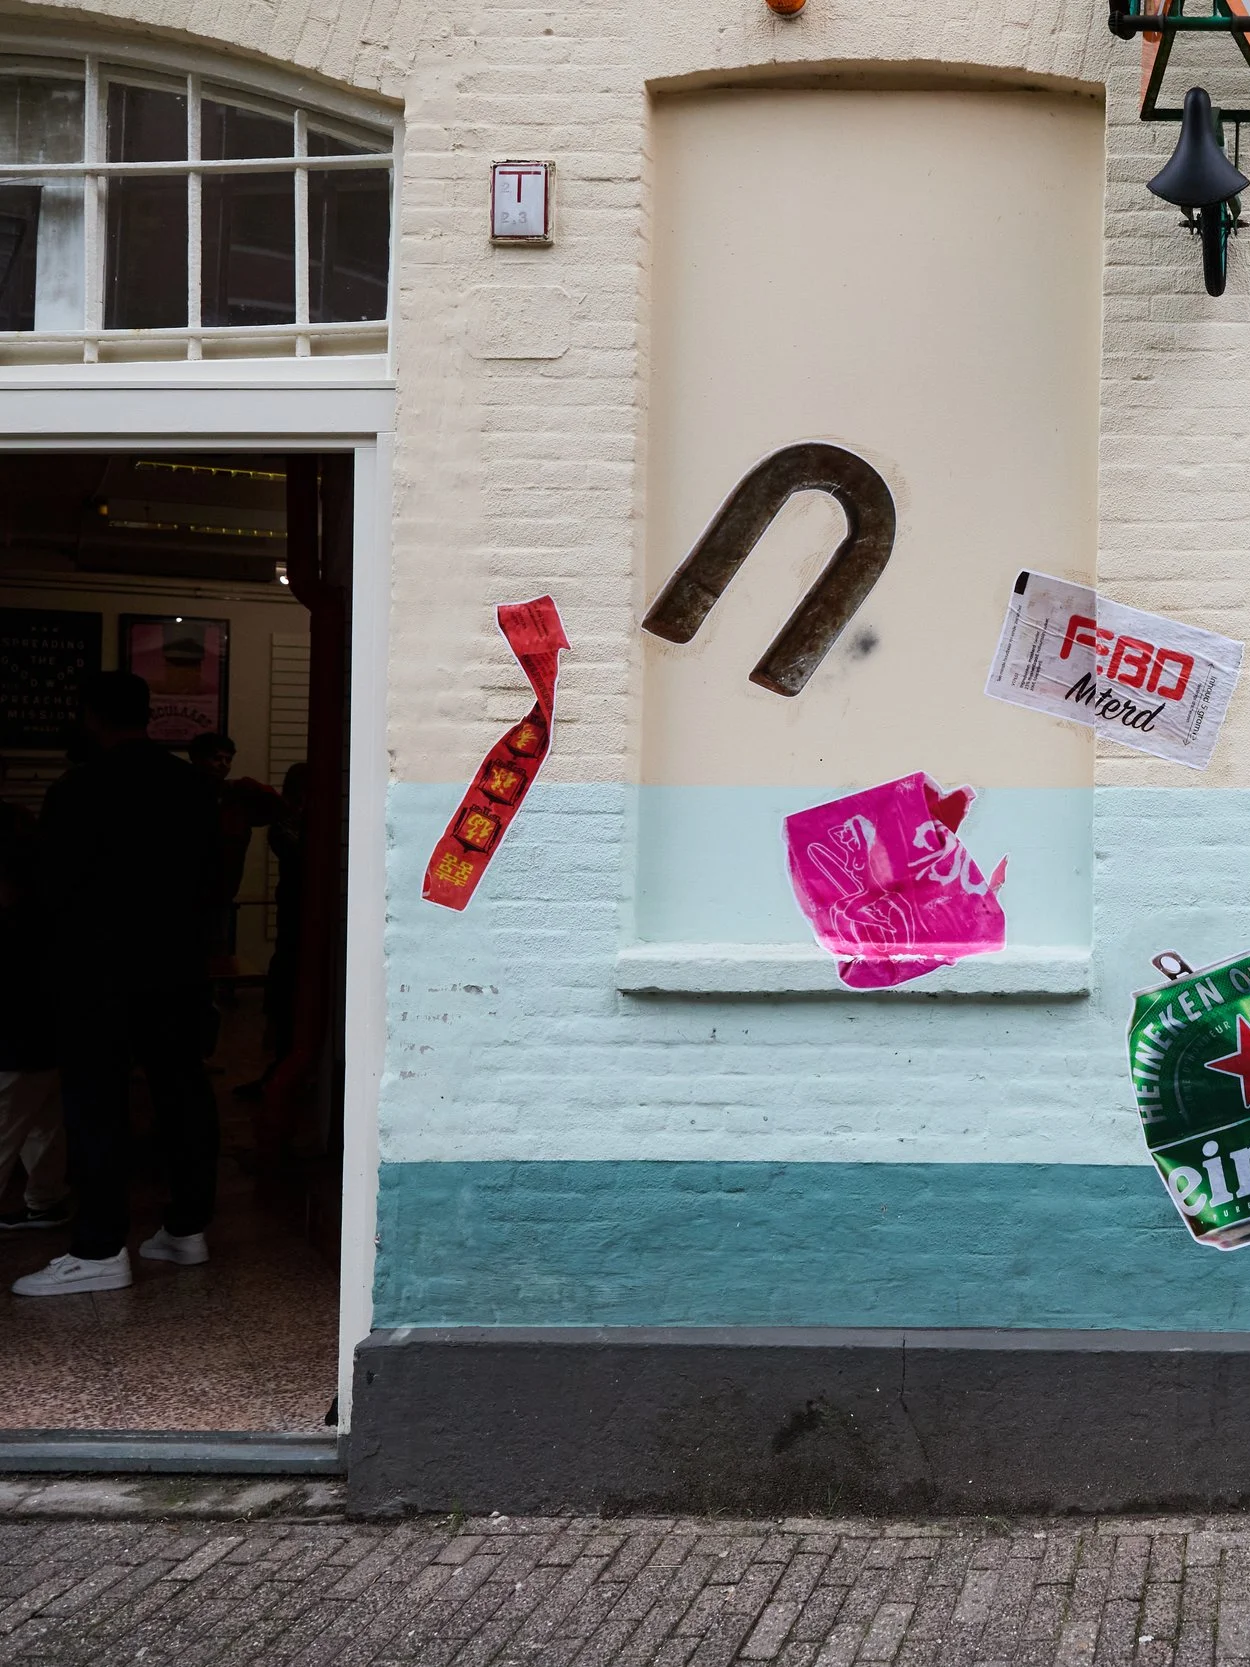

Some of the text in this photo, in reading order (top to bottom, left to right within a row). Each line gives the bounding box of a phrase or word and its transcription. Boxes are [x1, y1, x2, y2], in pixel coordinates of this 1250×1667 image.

[498, 170, 542, 203] T
[1059, 614, 1195, 702] FEBO
[1132, 976, 1226, 1125] HEINEKEN
